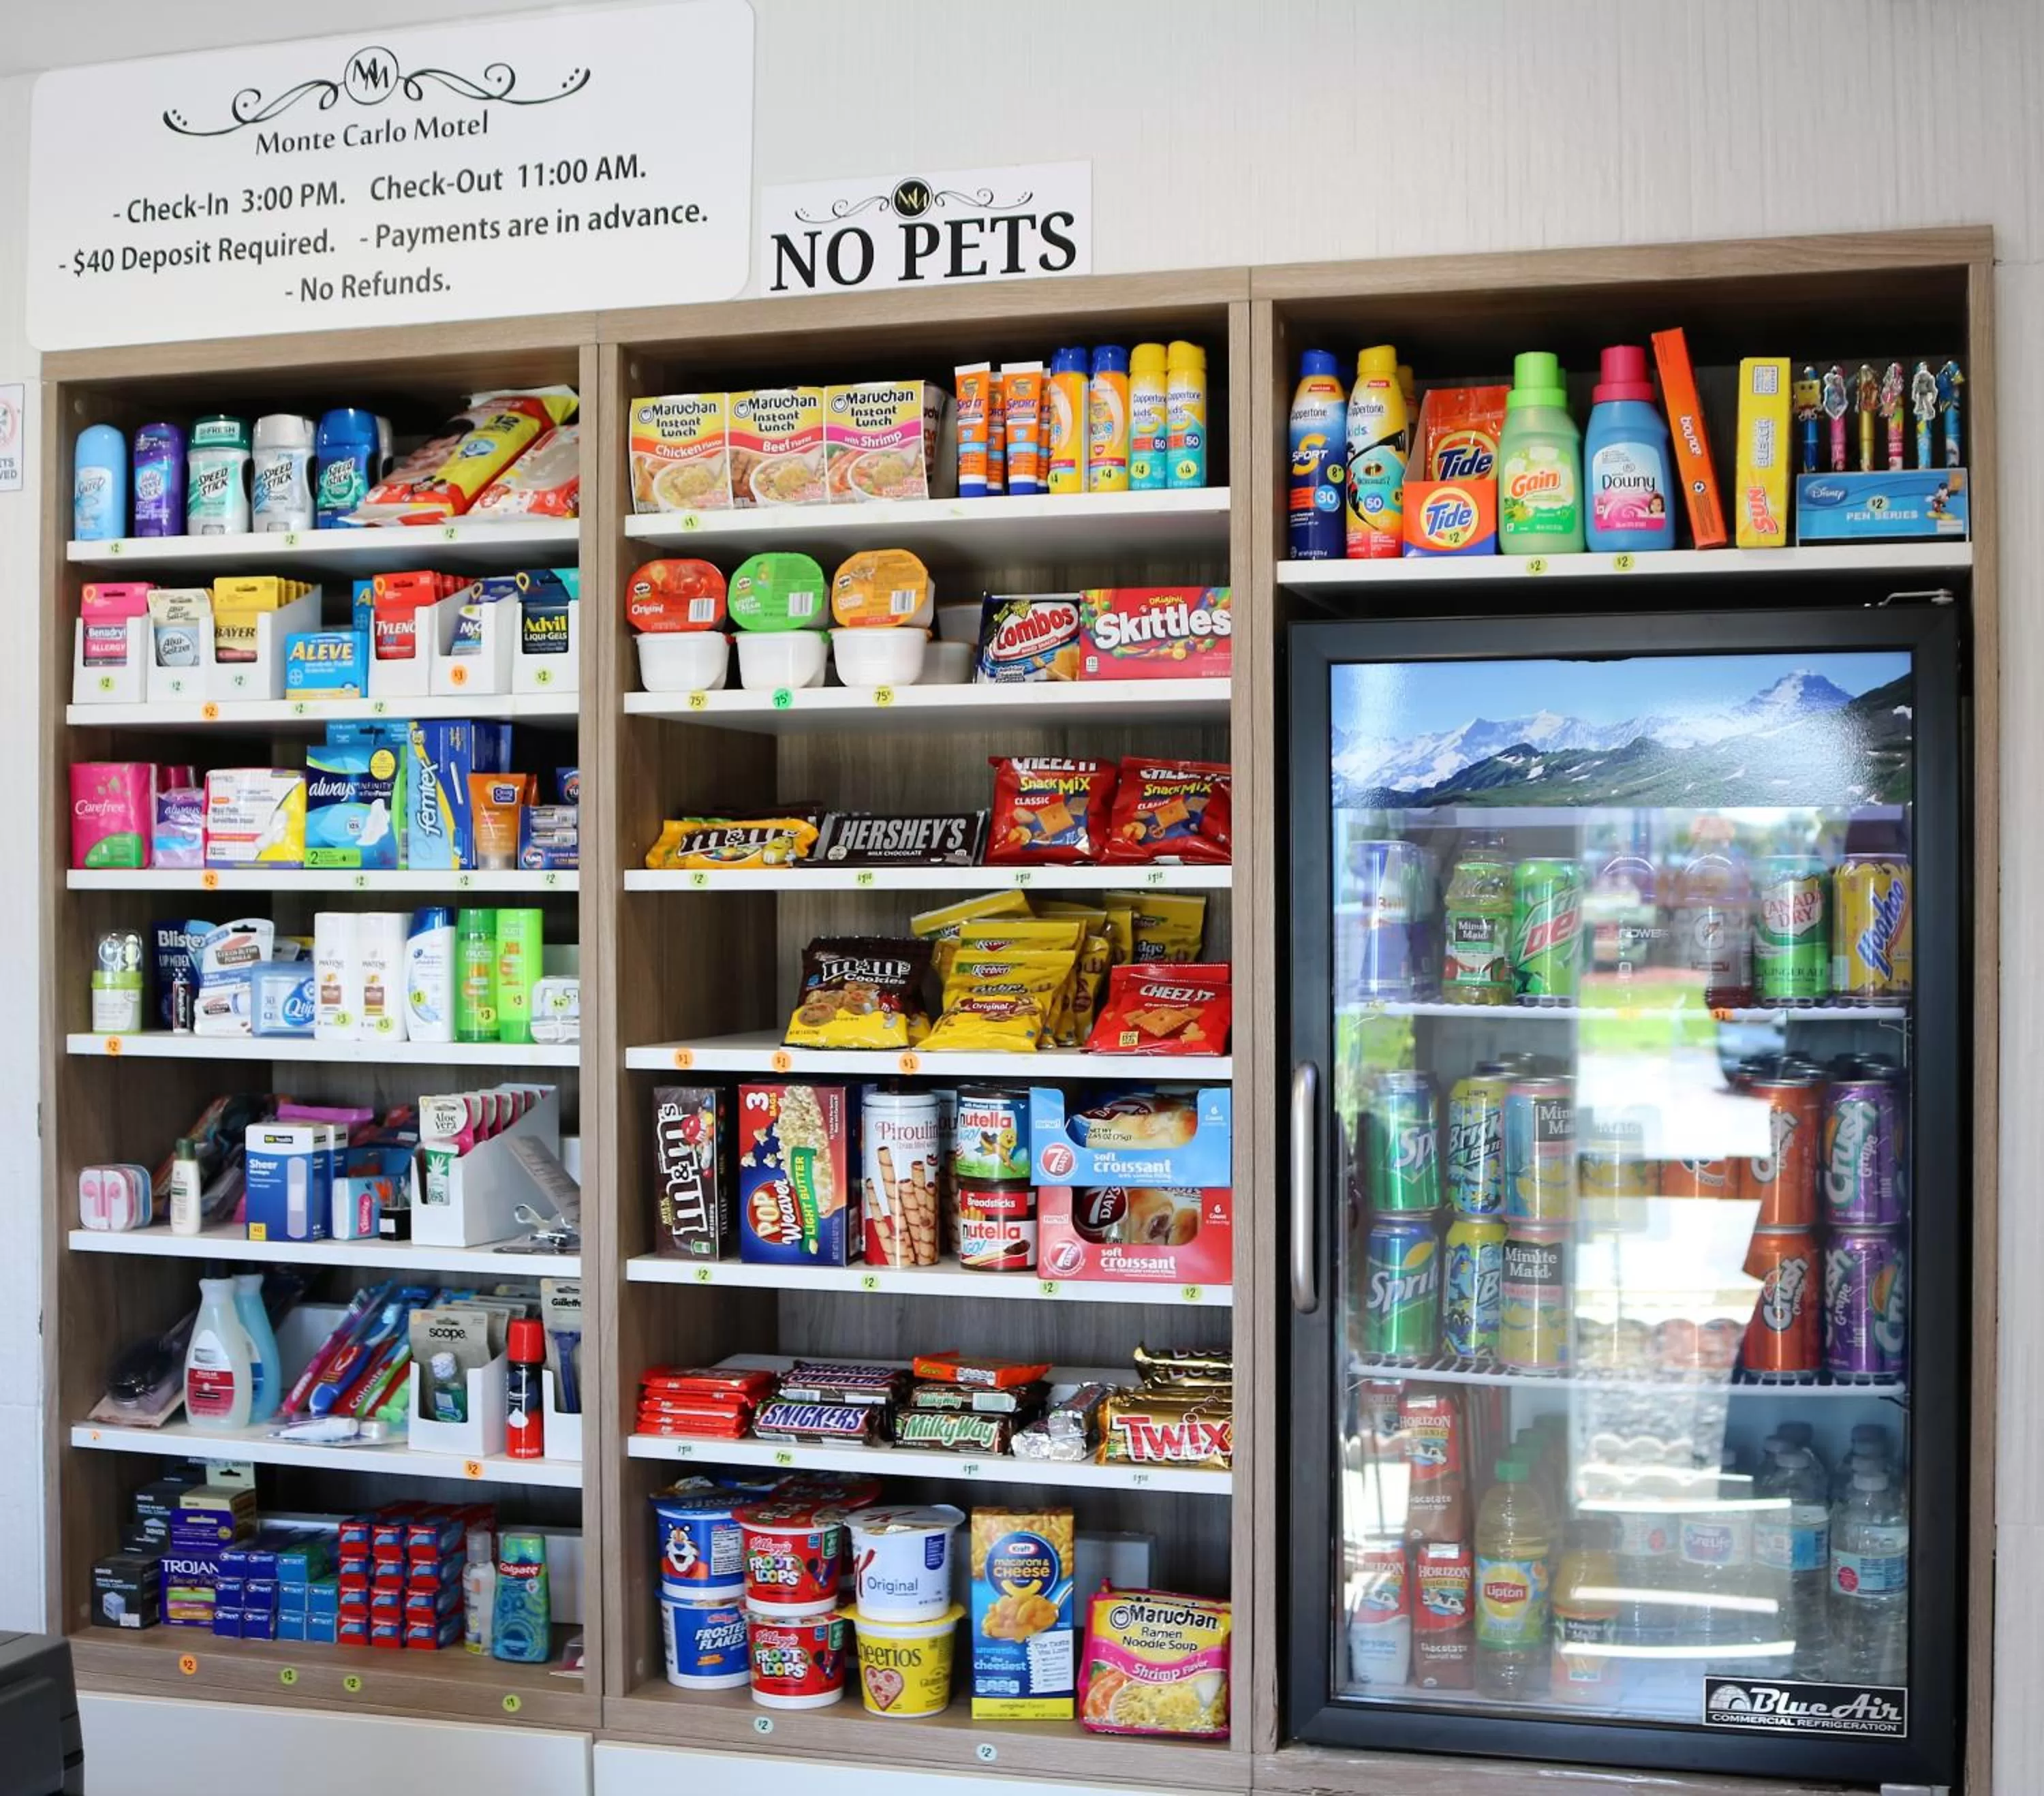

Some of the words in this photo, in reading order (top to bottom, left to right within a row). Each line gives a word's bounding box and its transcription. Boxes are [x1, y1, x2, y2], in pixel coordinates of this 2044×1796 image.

[256, 132, 335, 155] Monte
[343, 119, 407, 147] Carlo
[414, 110, 489, 142] Motel
[127, 192, 229, 224] Check-In
[241, 185, 294, 214] 3:00
[300, 181, 345, 208] PM.
[370, 166, 504, 202] Check-Out
[518, 158, 588, 188] 11:00
[595, 153, 647, 182] AM.
[375, 217, 501, 253] Payments
[508, 213, 548, 238] are
[556, 208, 580, 233] in
[588, 202, 708, 232] advance.
[73, 248, 114, 277] $40
[121, 239, 211, 274] Deposit
[219, 228, 335, 265] Required.
[769, 226, 875, 291] NO
[897, 211, 1077, 281] PETS
[300, 277, 333, 302] No
[341, 266, 451, 299] Refunds.
[748, 394, 817, 410] Maruchan
[846, 388, 914, 405] Maruchan
[652, 401, 717, 417] Maruchan
[752, 410, 800, 423] Instant
[850, 404, 897, 418] Instant
[656, 416, 702, 429] Instant
[758, 420, 795, 433] Lunch
[855, 415, 893, 428] Lunch
[661, 427, 697, 438] Lunch
[860, 430, 903, 449] Shrimp
[655, 443, 702, 459] Chicken
[762, 437, 791, 454] Beef
[1154, 439, 1166, 450] 50
[1291, 449, 1329, 463] SPORT
[1438, 446, 1494, 480] Tide
[198, 467, 229, 486] SPEED
[262, 461, 293, 482] SPEED
[200, 477, 228, 497] STICK
[266, 474, 293, 489] STICK
[1509, 468, 1560, 499] Gain
[1601, 474, 1656, 493] Downy
[1316, 491, 1337, 504] 30
[1809, 485, 1846, 501] Disney
[1426, 501, 1473, 536] Tide
[1748, 486, 1779, 535] SUN
[1846, 512, 1871, 521] PEN
[1874, 510, 1919, 521] SERIES
[375, 621, 417, 636] TYLENO
[525, 615, 568, 632] Advil
[995, 606, 1075, 649] Combos
[1094, 603, 1232, 650] Skittles
[215, 627, 256, 640] BAYER
[289, 641, 354, 662] ALEVE
[309, 777, 356, 802] always
[1020, 777, 1057, 791] Snack
[74, 799, 125, 816] Carefree
[1014, 796, 1050, 806] CLASSIC
[841, 818, 966, 850] HERSHEY'S
[1778, 908, 1813, 928] DRY
[844, 974, 906, 985] Cookies
[972, 1002, 1010, 1012] Original
[745, 1091, 769, 1111] 3
[769, 1091, 777, 1117] BAGS
[435, 1113, 456, 1123] Aloe
[959, 1111, 1012, 1129] nutella
[249, 1159, 278, 1170] Sheer
[1093, 1152, 1115, 1162] soft
[1093, 1160, 1172, 1174] croissant
[792, 1155, 813, 1201] BUTTER
[967, 1195, 1016, 1208] Breadsticks
[755, 1189, 778, 1238] POP
[780, 1179, 803, 1246] Weaver
[804, 1201, 816, 1237] LIGHT
[961, 1223, 1021, 1241] nutella
[1100, 1248, 1123, 1258] soft
[1504, 1246, 1558, 1265] Minute
[1100, 1256, 1176, 1270] croissant
[1509, 1261, 1549, 1279] Maid
[428, 1327, 466, 1341] scope
[762, 1404, 866, 1430] SNICKERS
[1399, 1414, 1451, 1429] HORIZON
[1115, 1416, 1232, 1464] Twix
[161, 1559, 219, 1575] TROJAN
[499, 1562, 539, 1577] Colgate
[749, 1555, 796, 1570] FROOT
[755, 1568, 801, 1586] LOOPS
[1418, 1564, 1471, 1579] HORIZON
[867, 1576, 919, 1595] Original
[1486, 1585, 1524, 1600] Lipton
[1129, 1603, 1219, 1630] Maruchan
[1141, 1627, 1183, 1639] Ramen
[698, 1633, 745, 1652] FLAKES
[1122, 1636, 1167, 1650] Noodle
[1168, 1639, 1198, 1652] Soup
[756, 1648, 803, 1664] FROOT
[760, 1661, 808, 1680] LOOPS
[1132, 1662, 1180, 1682] Shrimp
[1711, 1712, 1796, 1727] COMMERCIAL
[1796, 1719, 1898, 1733] REFRIGERATION
